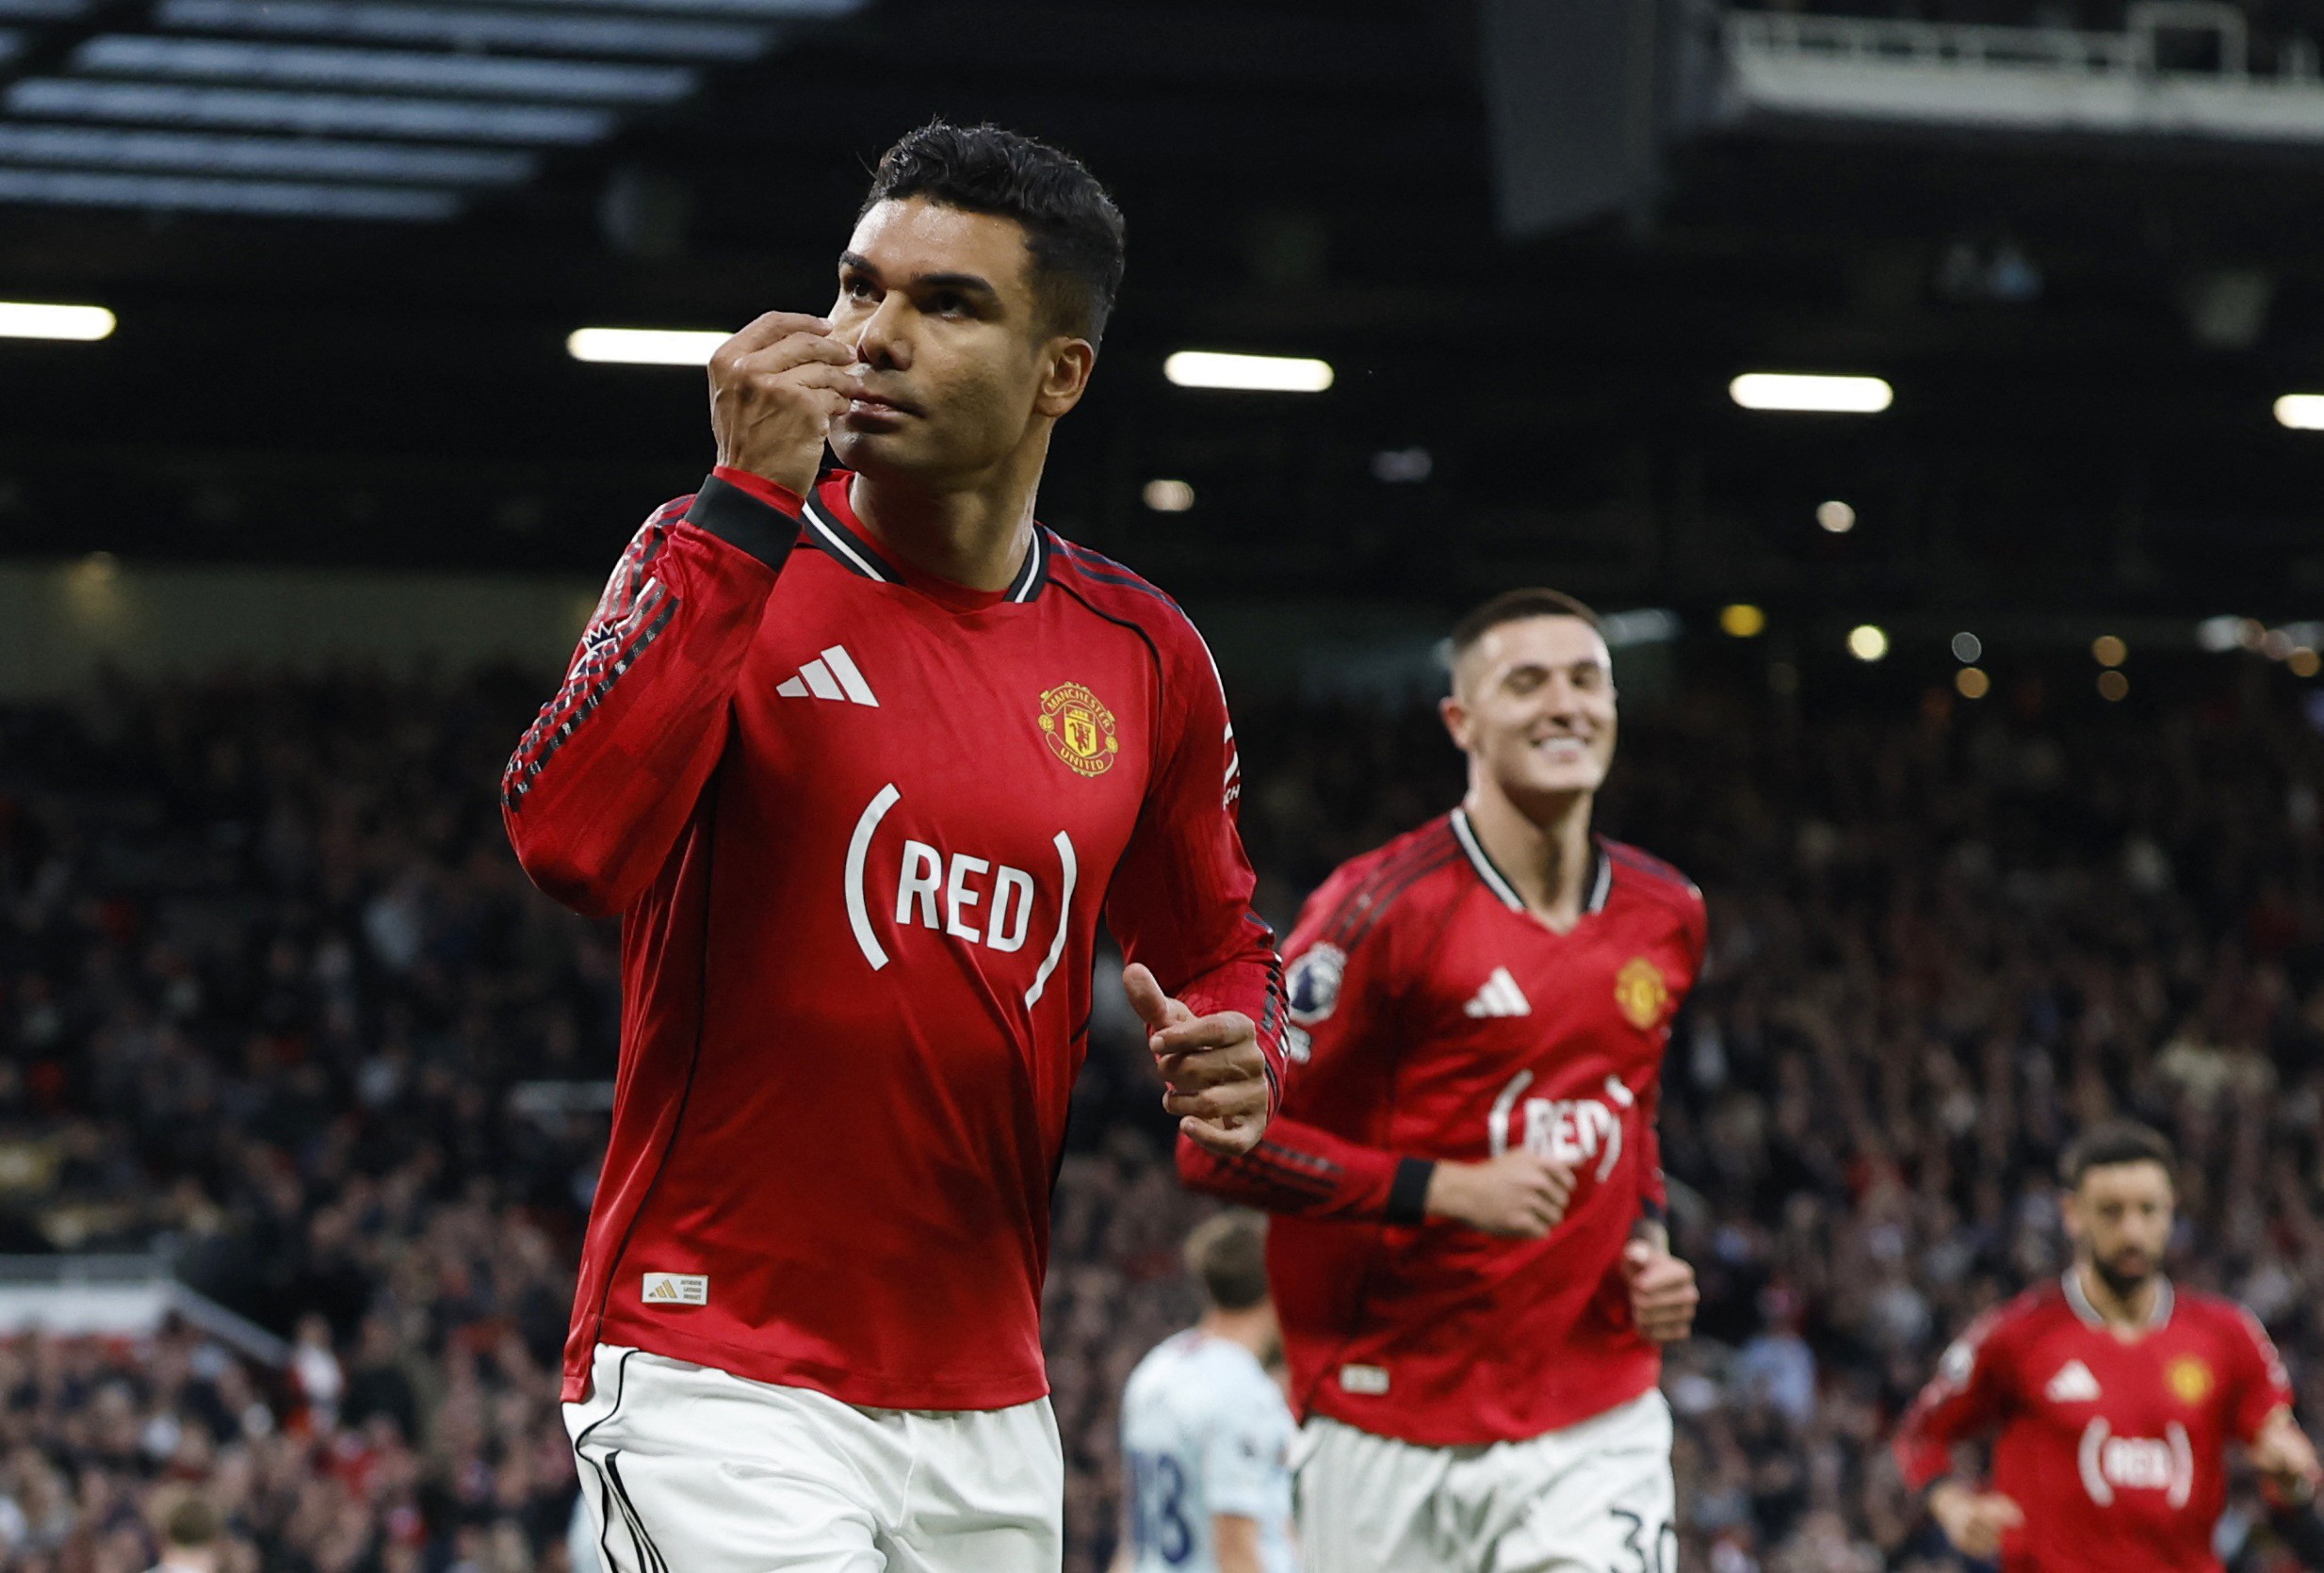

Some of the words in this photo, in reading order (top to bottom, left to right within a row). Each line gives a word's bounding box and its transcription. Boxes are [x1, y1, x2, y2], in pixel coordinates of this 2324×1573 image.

[1047, 689, 1111, 729] MANCHESTER
[1060, 747, 1104, 770] UNITED
[844, 782, 1078, 1012] (RED)
